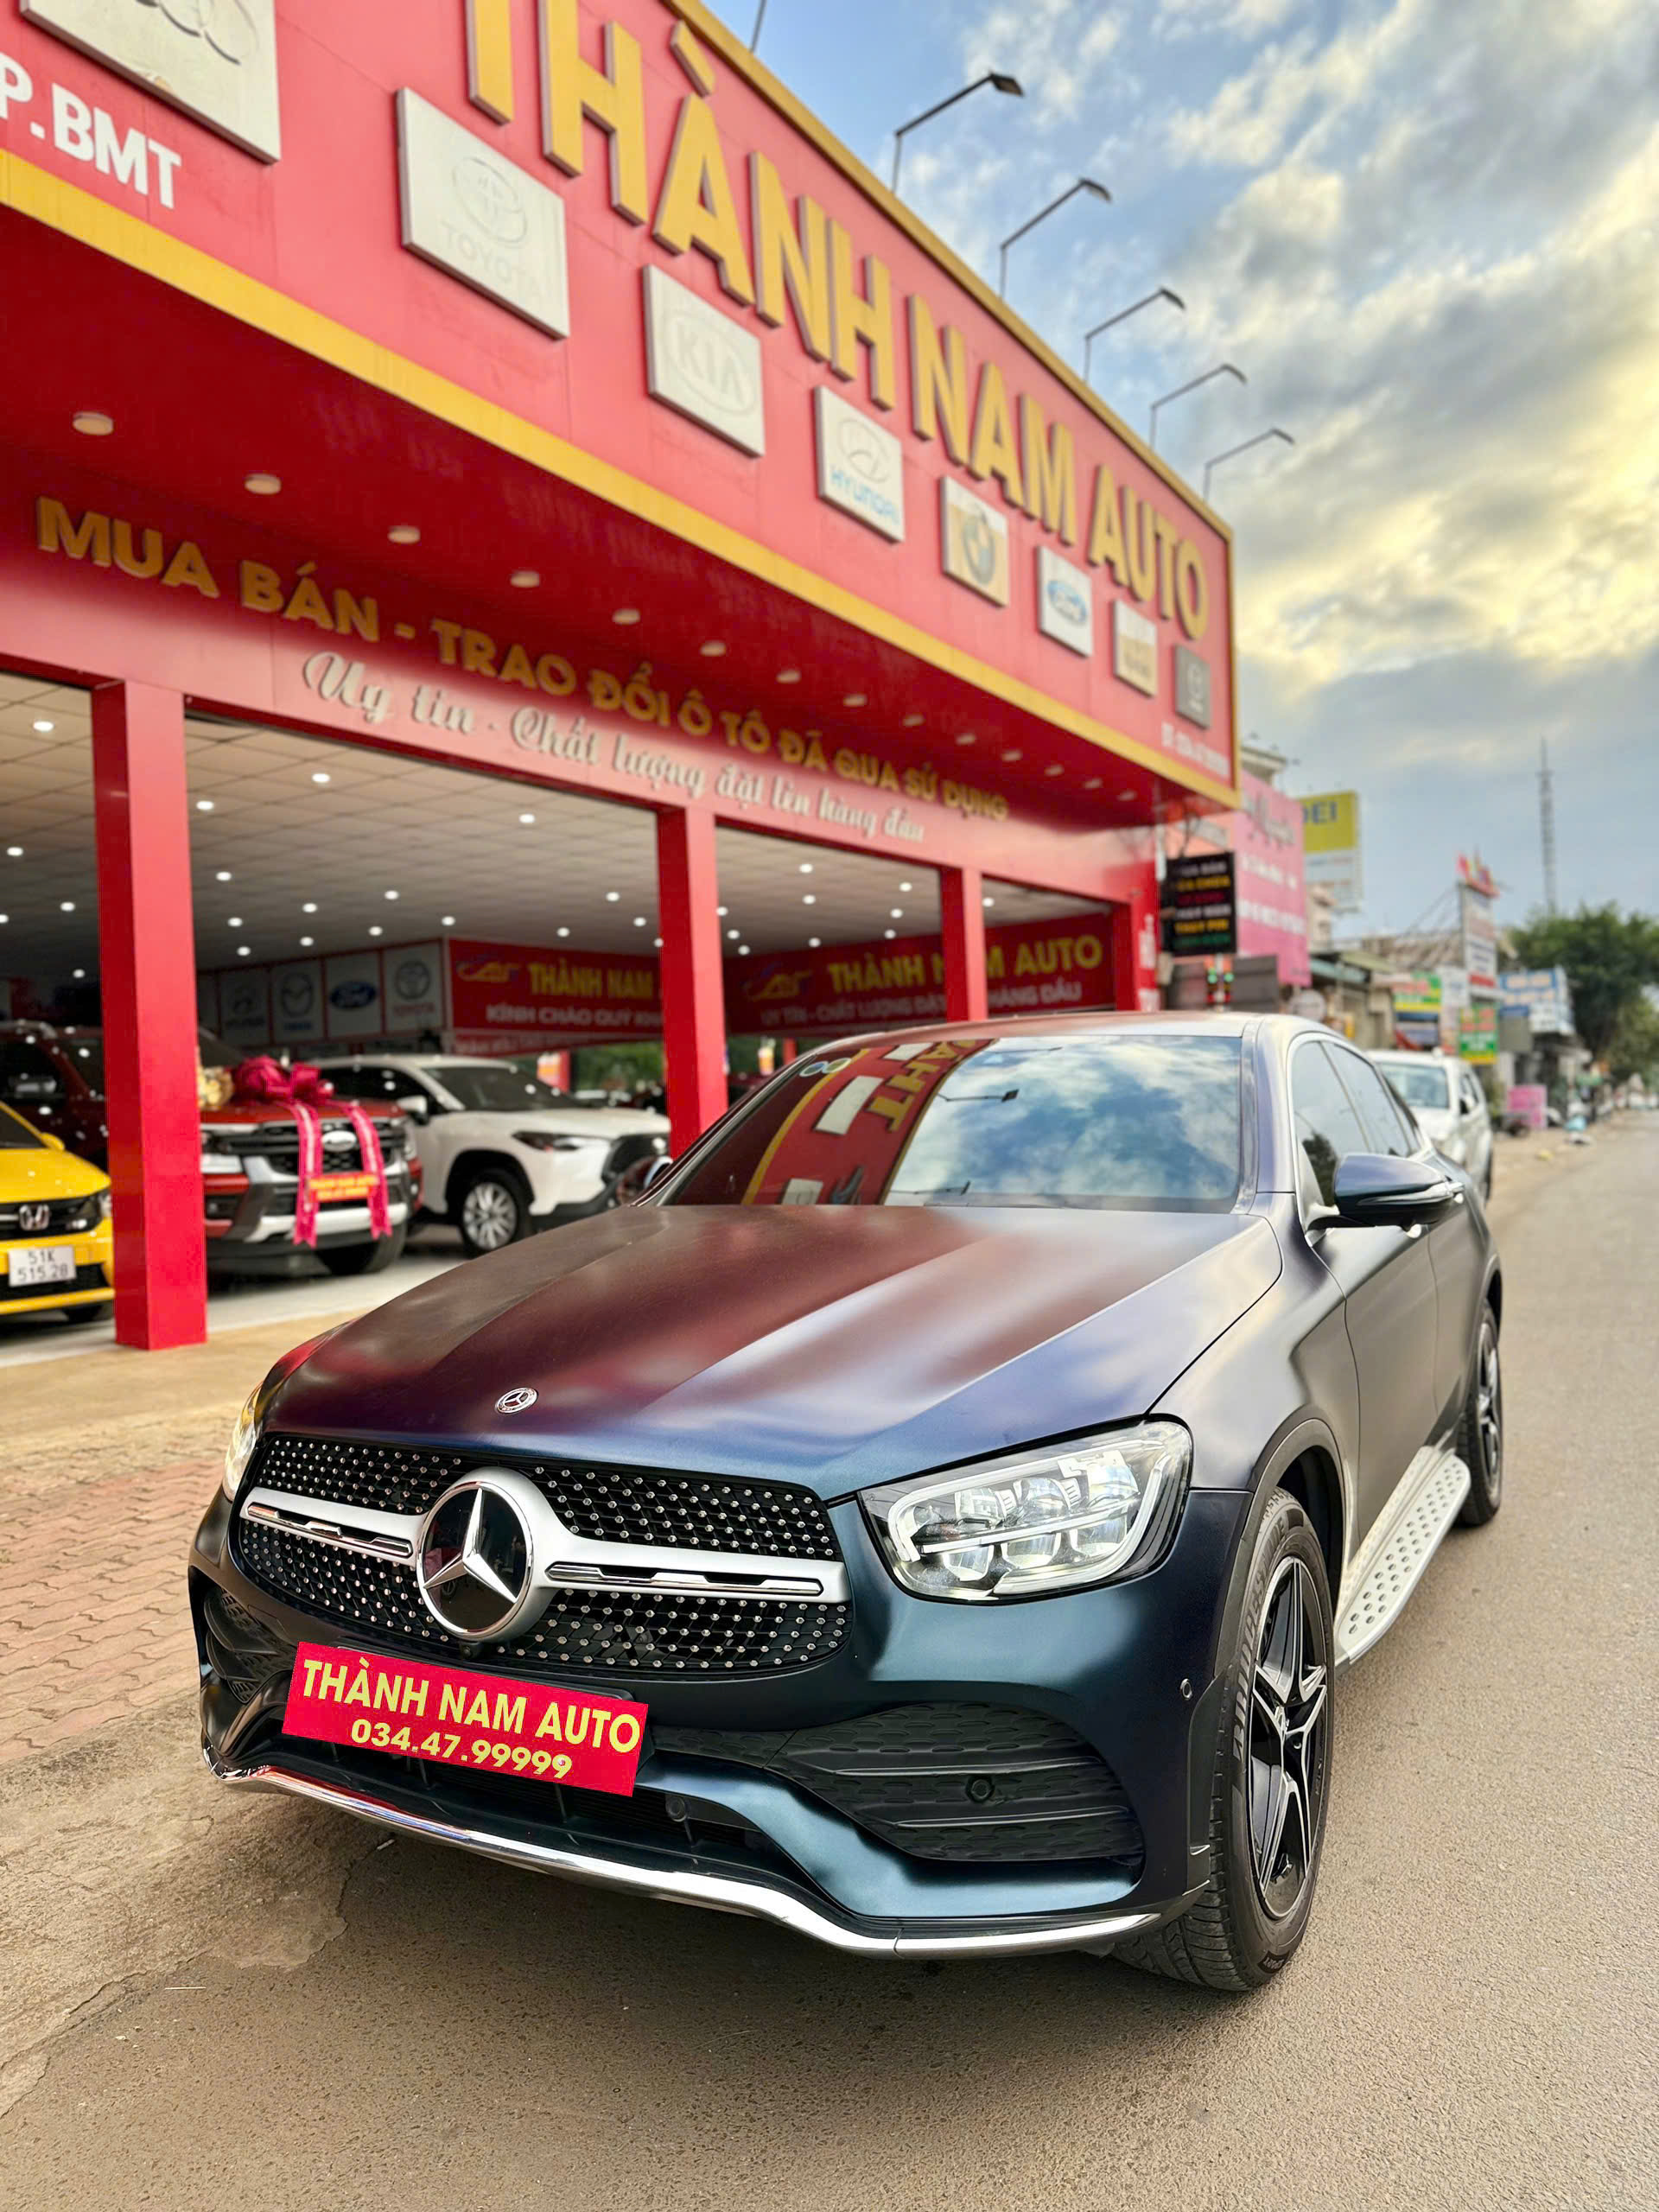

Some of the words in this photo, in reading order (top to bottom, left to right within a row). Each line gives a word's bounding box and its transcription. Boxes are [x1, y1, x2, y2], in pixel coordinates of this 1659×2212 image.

[0, 51, 182, 210] P.BMT
[908, 294, 1077, 547] NAM
[1088, 464, 1209, 642] AUTO
[37, 496, 219, 597] MUA
[240, 560, 378, 642] BÁN
[432, 619, 576, 696] TRAO
[588, 662, 671, 728] ĐỔI
[678, 689, 713, 737] Ô
[720, 709, 771, 753] TÔ
[779, 729, 829, 772] ĐÃ
[834, 748, 899, 791] QUA
[302, 652, 393, 724] Uy
[528, 957, 602, 997] THÀNH
[608, 969, 653, 1000] NAM
[828, 952, 925, 993] THÀNH
[1014, 935, 1103, 977] AUTO
[28, 1249, 56, 1265] 51K
[302, 1656, 429, 1717] THÀNH
[439, 1683, 527, 1735] NAM
[537, 1702, 640, 1753] AUTO
[351, 1719, 573, 1778] 034.47.99999
